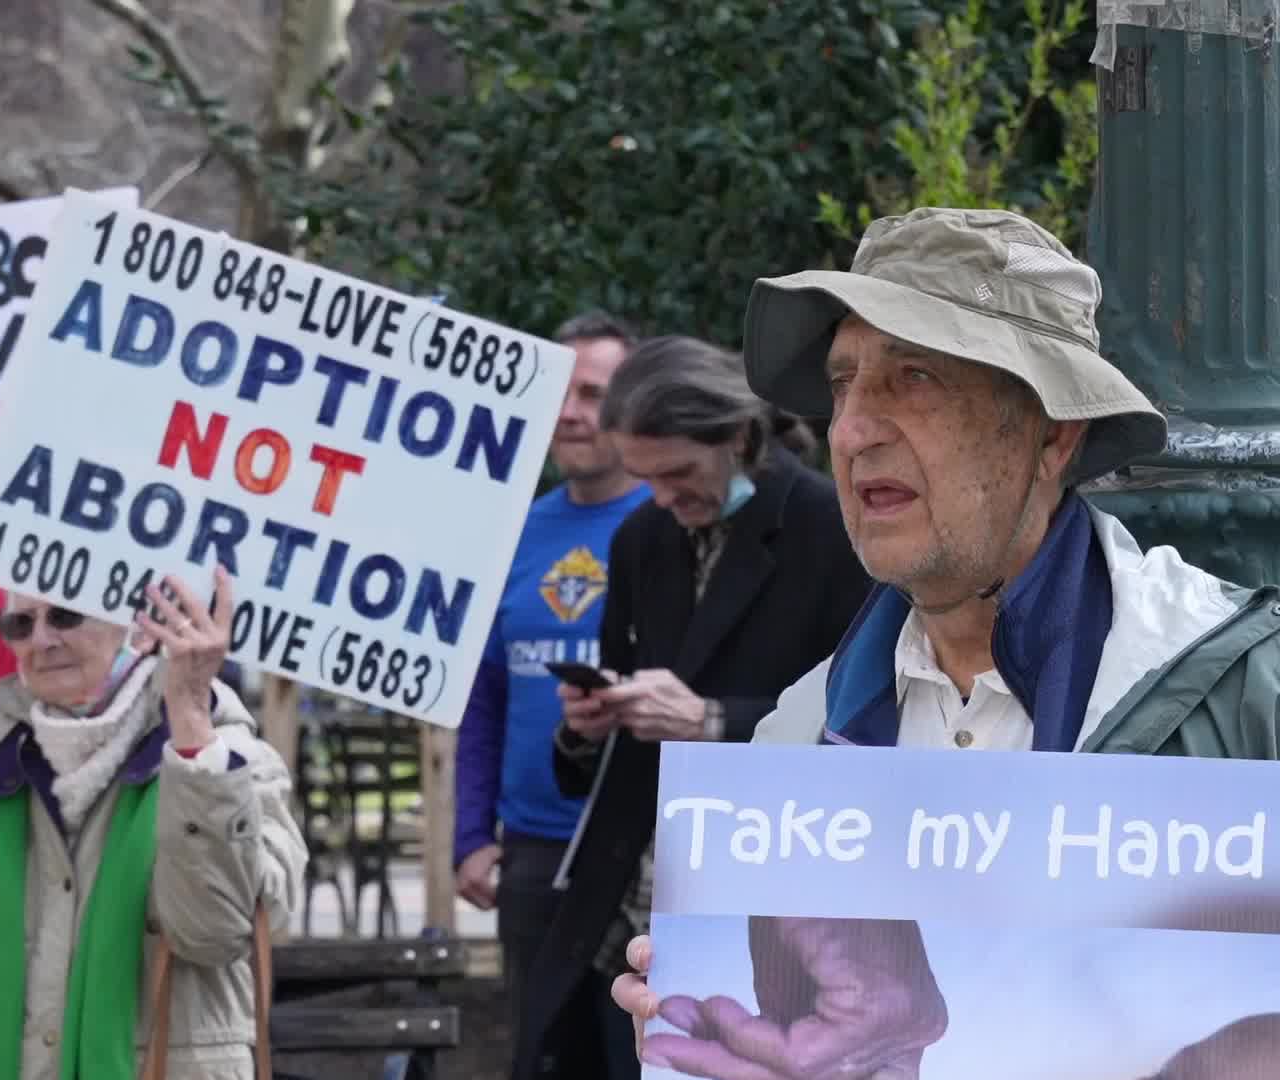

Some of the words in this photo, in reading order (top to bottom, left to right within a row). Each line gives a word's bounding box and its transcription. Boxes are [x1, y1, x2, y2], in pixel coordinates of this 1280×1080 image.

[50, 278, 527, 484] ADOPTION
[92, 210, 118, 265] 1
[123, 221, 204, 290] 800
[213, 248, 407, 358] 848-LOVE
[409, 310, 539, 399] (5683)
[0, 444, 476, 647] ABORTION
[157, 400, 367, 518] NOT
[11, 533, 91, 600] 800
[320, 625, 448, 713] (5683)
[663, 797, 872, 870] Take
[907, 808, 1011, 873] my
[1047, 804, 1266, 879] Hand
